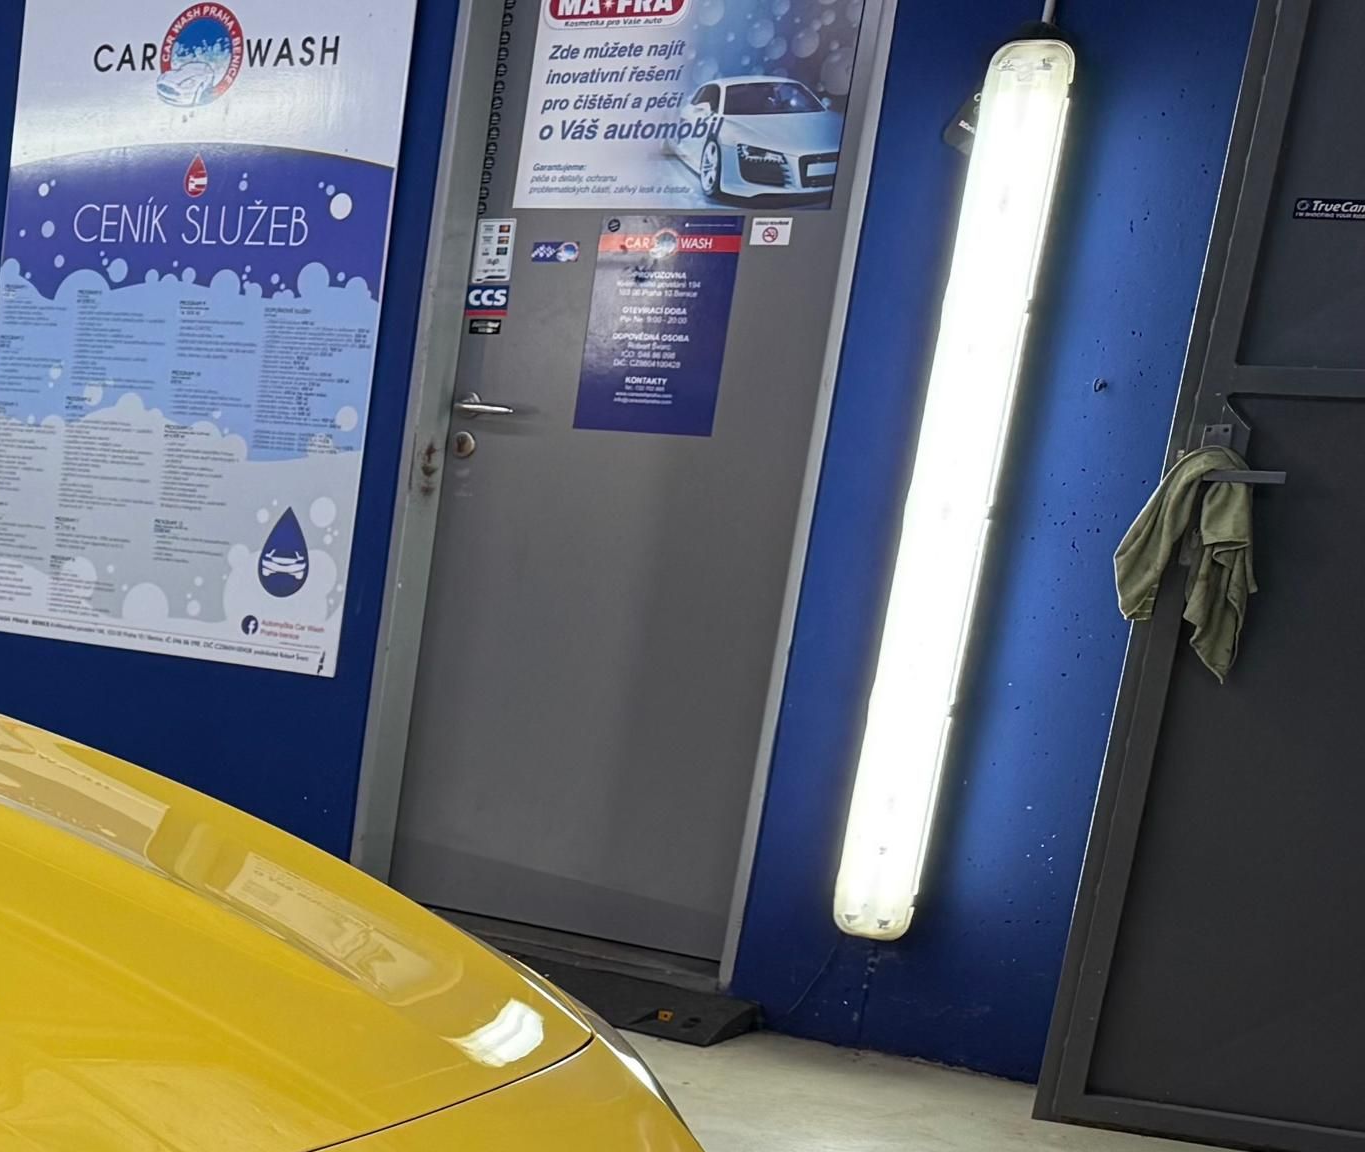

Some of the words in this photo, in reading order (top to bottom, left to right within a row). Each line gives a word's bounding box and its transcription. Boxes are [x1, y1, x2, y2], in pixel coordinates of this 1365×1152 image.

[606, 19, 620, 28] pro
[643, 17, 663, 25] auto
[93, 43, 157, 73] CAR
[246, 35, 341, 68] WASH
[172, 8, 200, 35] WASH
[203, 5, 234, 33] PRAHA
[224, 36, 242, 86] BENICE
[548, 44, 580, 60] Zde
[583, 42, 643, 59] můžete
[647, 40, 686, 60] najít
[545, 66, 627, 85] inovativní
[628, 65, 684, 83] řešení
[540, 98, 569, 115] pro
[573, 93, 631, 111] čištění
[631, 98, 642, 110] a
[645, 91, 684, 113] péči
[538, 124, 554, 141] o
[560, 118, 600, 141] Váš
[603, 116, 725, 141] automobil
[73, 196, 169, 245] CENÍK
[180, 198, 309, 247] SLUŽEB
[624, 237, 650, 249] CAR
[680, 238, 714, 249] WASH
[468, 289, 508, 306] CCS
[624, 376, 668, 385] KONTAKTY
